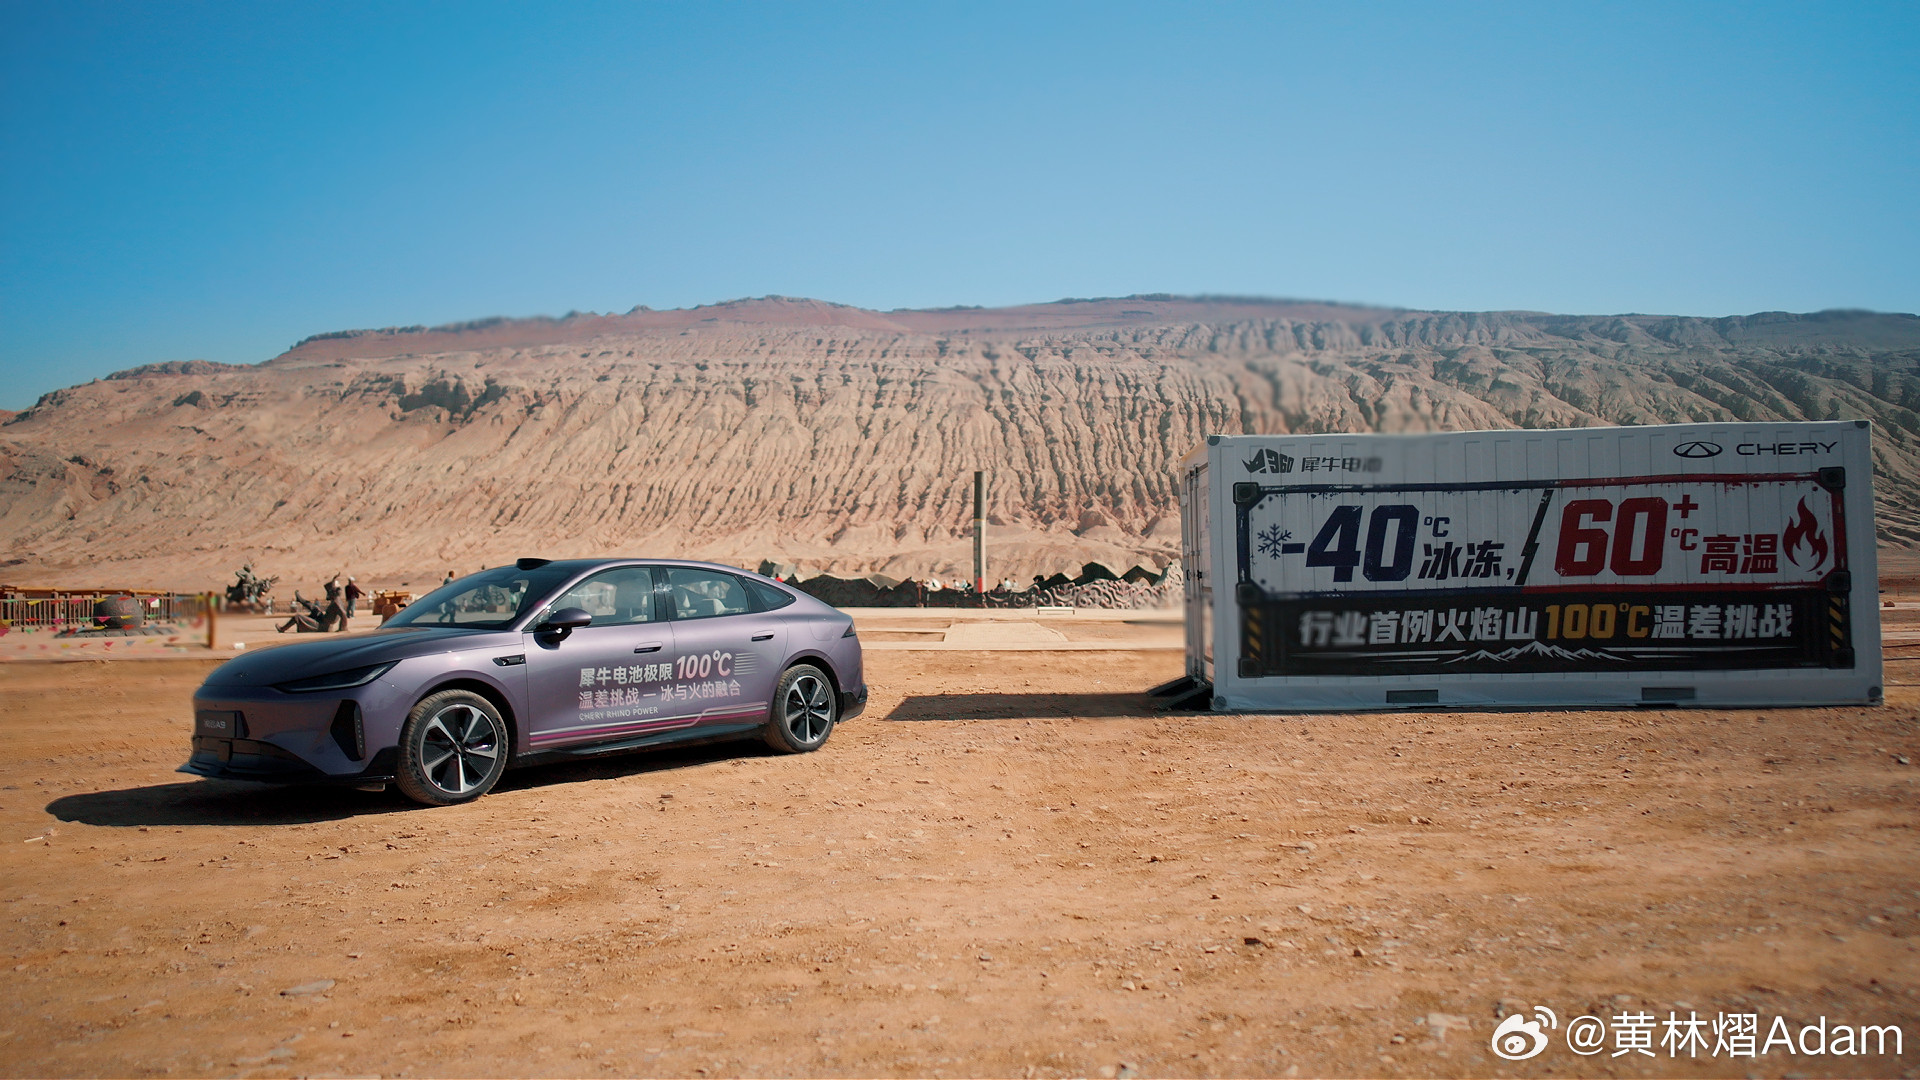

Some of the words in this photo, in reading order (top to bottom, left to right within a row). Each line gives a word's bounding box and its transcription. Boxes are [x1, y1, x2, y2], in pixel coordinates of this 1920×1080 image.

[1736, 441, 1838, 456] CHERY
[579, 710, 605, 722] CHERY
[606, 708, 631, 719] RHINO
[632, 706, 659, 717] POWER
